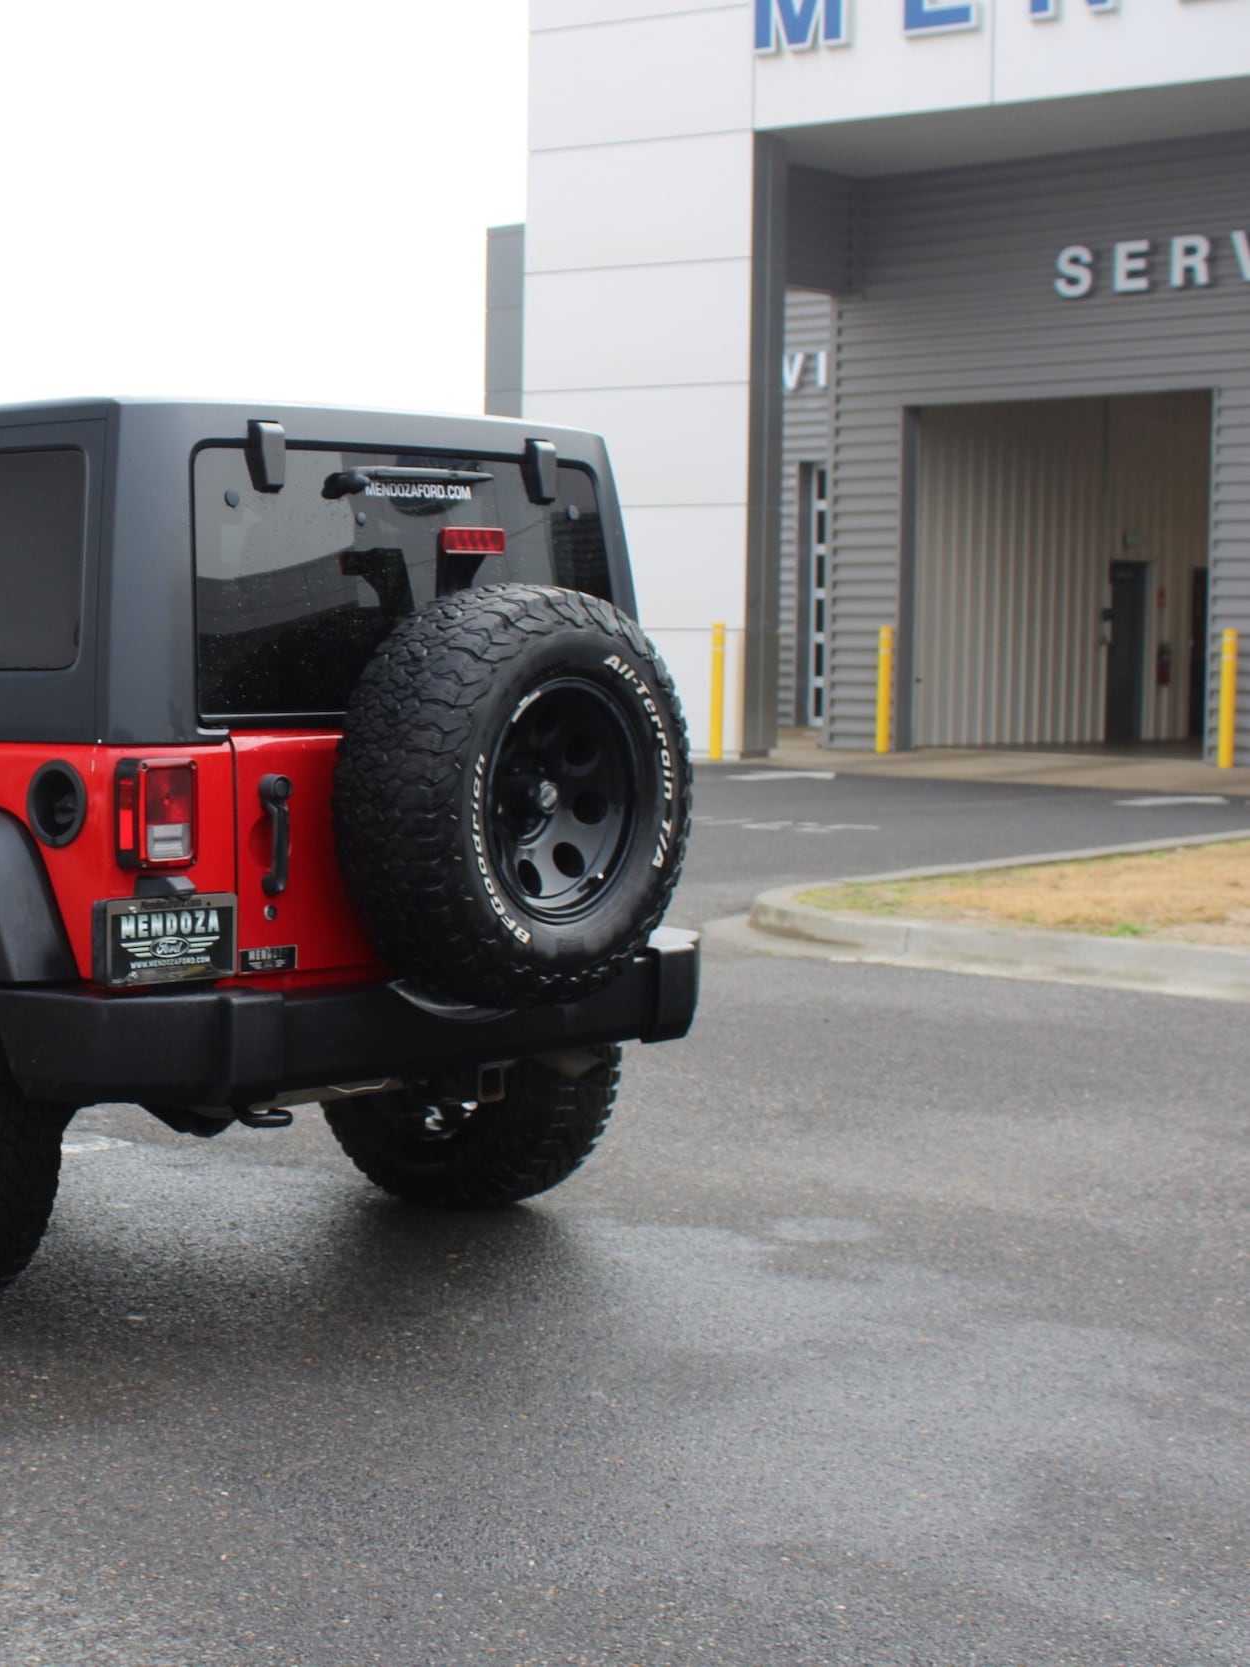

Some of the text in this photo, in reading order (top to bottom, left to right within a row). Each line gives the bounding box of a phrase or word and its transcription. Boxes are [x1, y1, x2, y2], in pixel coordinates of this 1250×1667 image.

[365, 481, 472, 500] MENDOZAFORD.COM
[603, 653, 675, 870] All-Terrain T/A
[471, 753, 532, 945] BFGoodrich
[120, 909, 220, 940] MENDOZA
[155, 939, 183, 956] Ford
